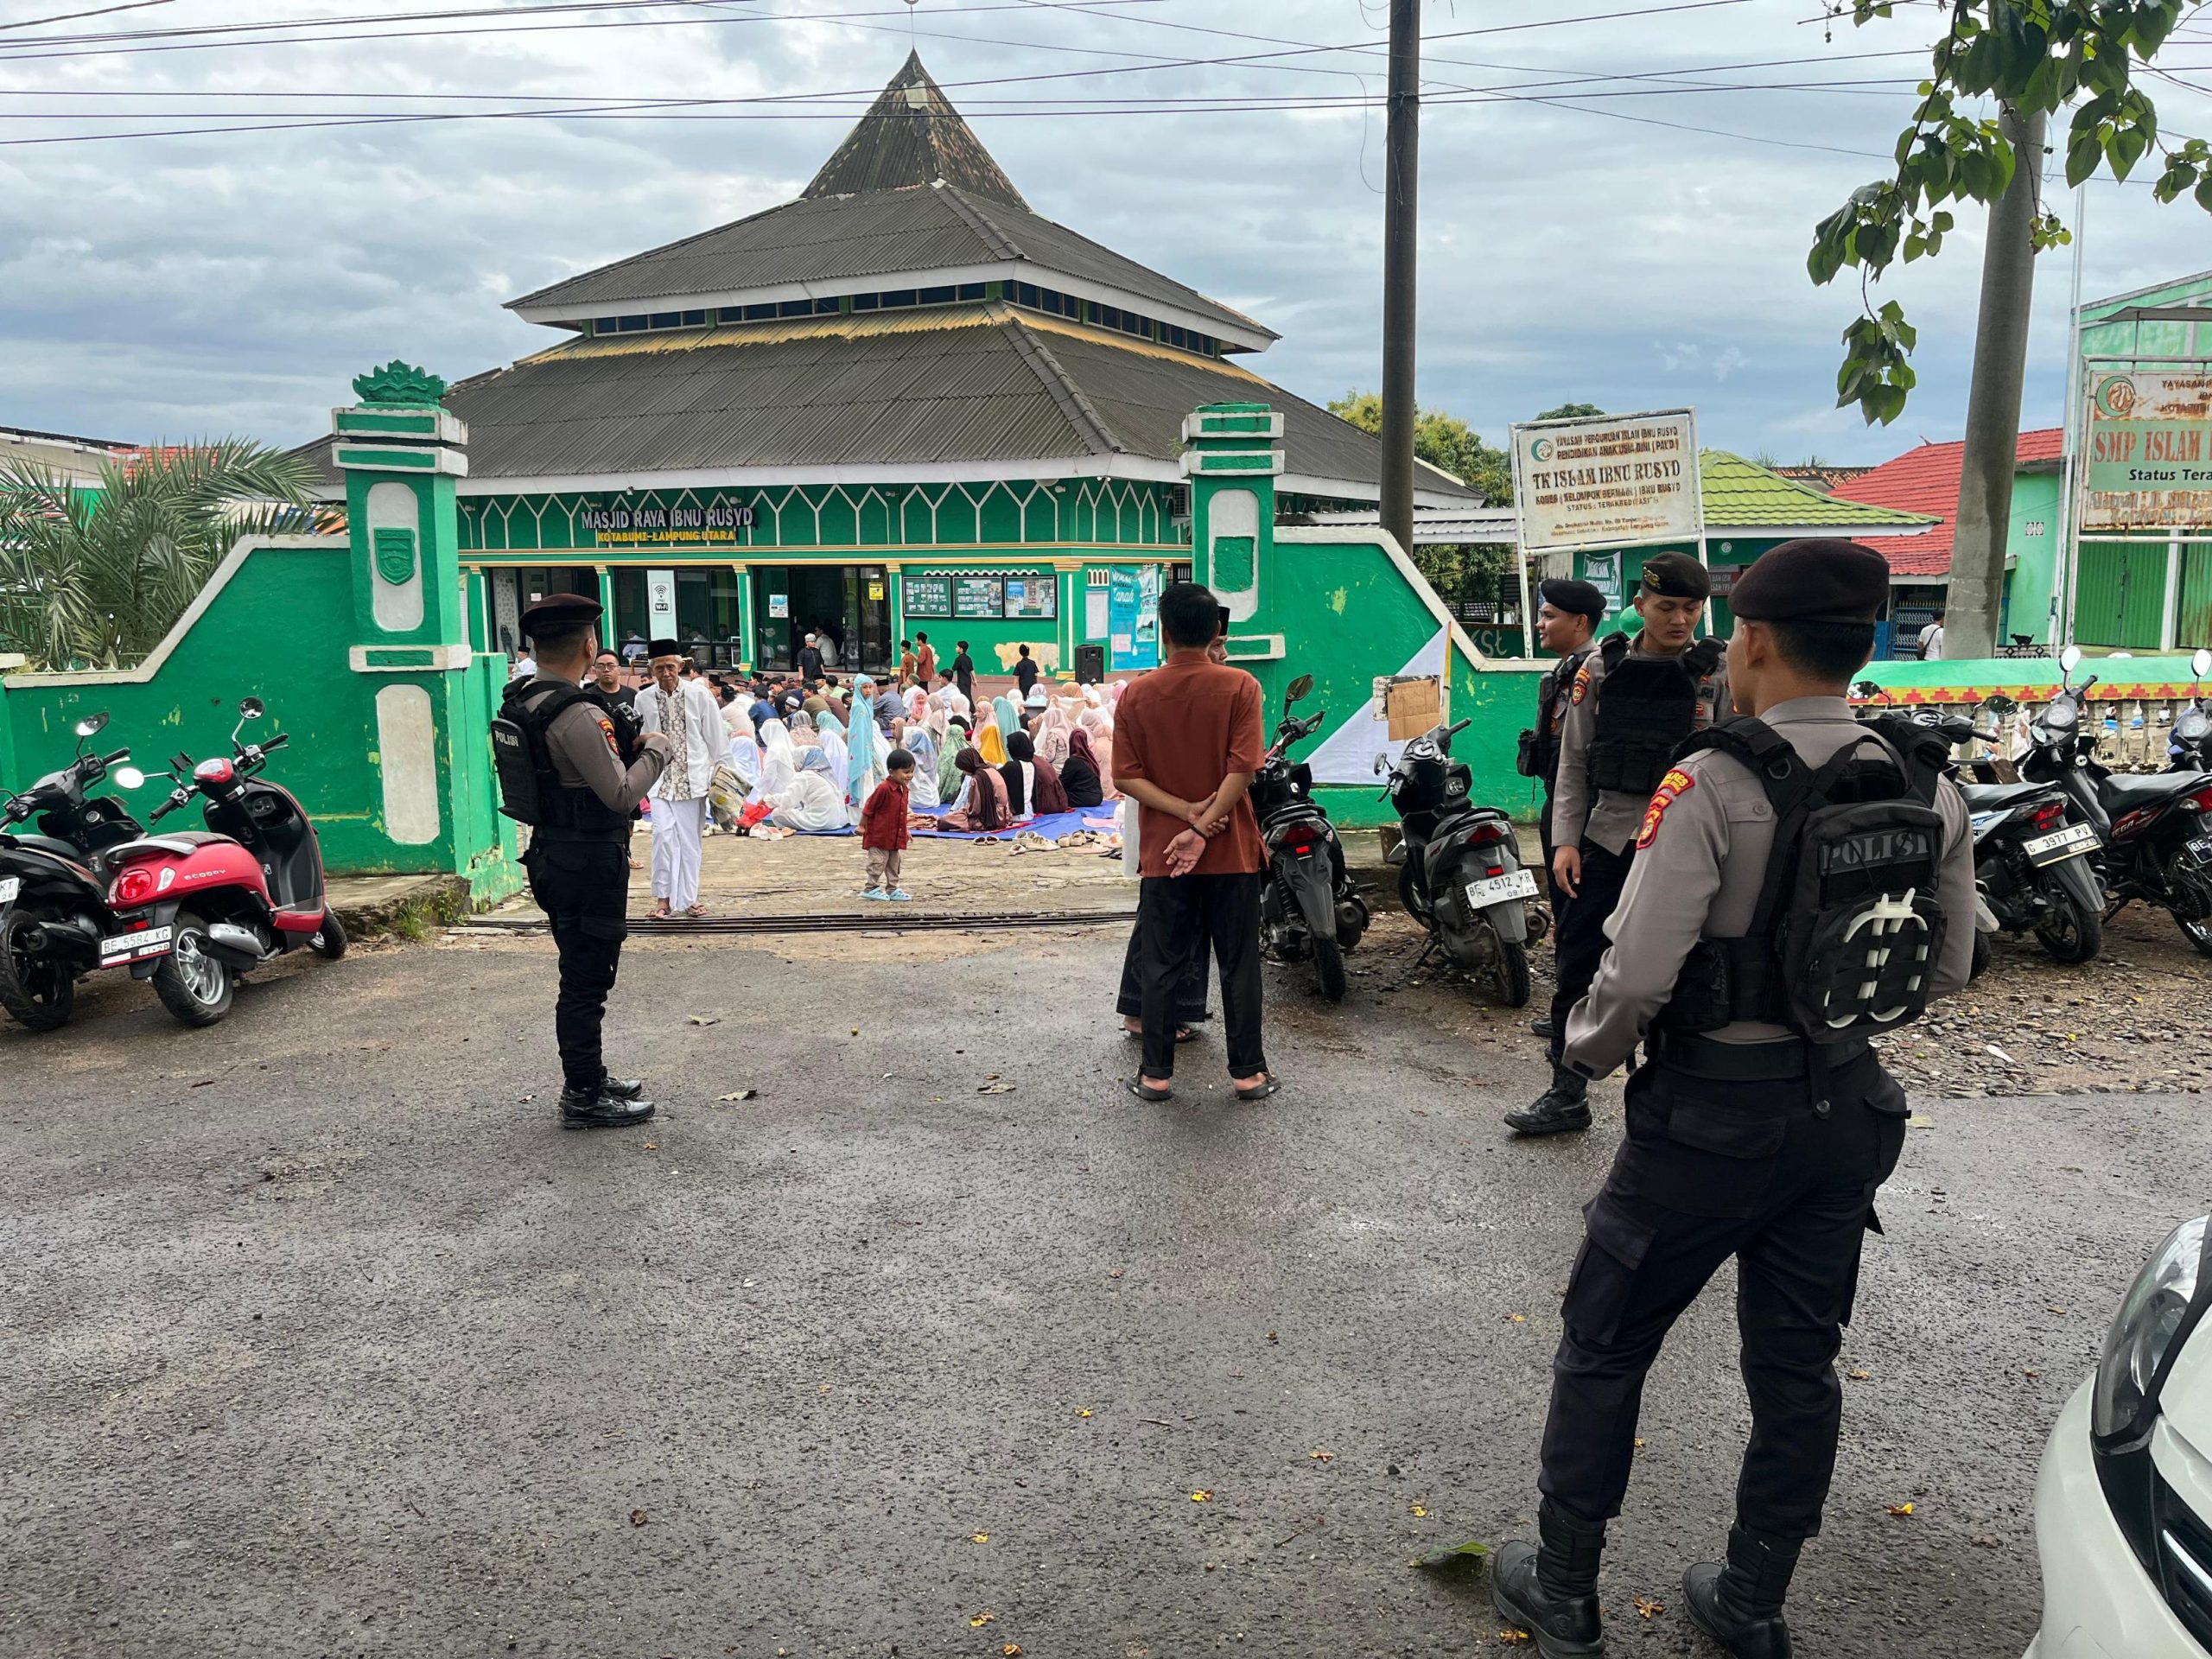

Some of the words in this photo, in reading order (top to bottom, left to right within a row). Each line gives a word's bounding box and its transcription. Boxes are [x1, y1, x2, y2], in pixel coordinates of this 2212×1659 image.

[2162, 379, 2204, 389] YAYASAN
[1585, 431, 1622, 444] PERGURUAN
[1621, 429, 1640, 440] ISLAM
[1641, 427, 1656, 439] IBNU
[1657, 426, 1679, 437] RUSYD
[1557, 447, 1599, 461] PENDIDIKAN
[1599, 443, 1619, 457] ANAK
[2094, 431, 2137, 463] SMP
[2145, 430, 2201, 462] ISLAM
[1533, 472, 1551, 490] TK
[1554, 468, 1597, 488] ISLAM
[1599, 464, 1631, 485] IBNU
[1635, 460, 1681, 481] RUSYD
[2129, 468, 2176, 480] Status
[1657, 481, 1681, 493] RUSYD
[582, 511, 629, 530] MASJID
[633, 510, 666, 528] RAYA
[671, 508, 702, 527] IBNU
[707, 506, 753, 526] RUSYD
[702, 530, 734, 541] UTARA
[2042, 832, 2068, 849] 3977
[2075, 826, 2088, 838] PV
[2190, 839, 2209, 852] BE
[1821, 831, 1929, 871] POLISI
[1489, 876, 1513, 891] 4512
[1518, 872, 1532, 883] KR
[104, 939, 118, 953] BE
[124, 932, 149, 948] 5584
[156, 928, 168, 941] KG
